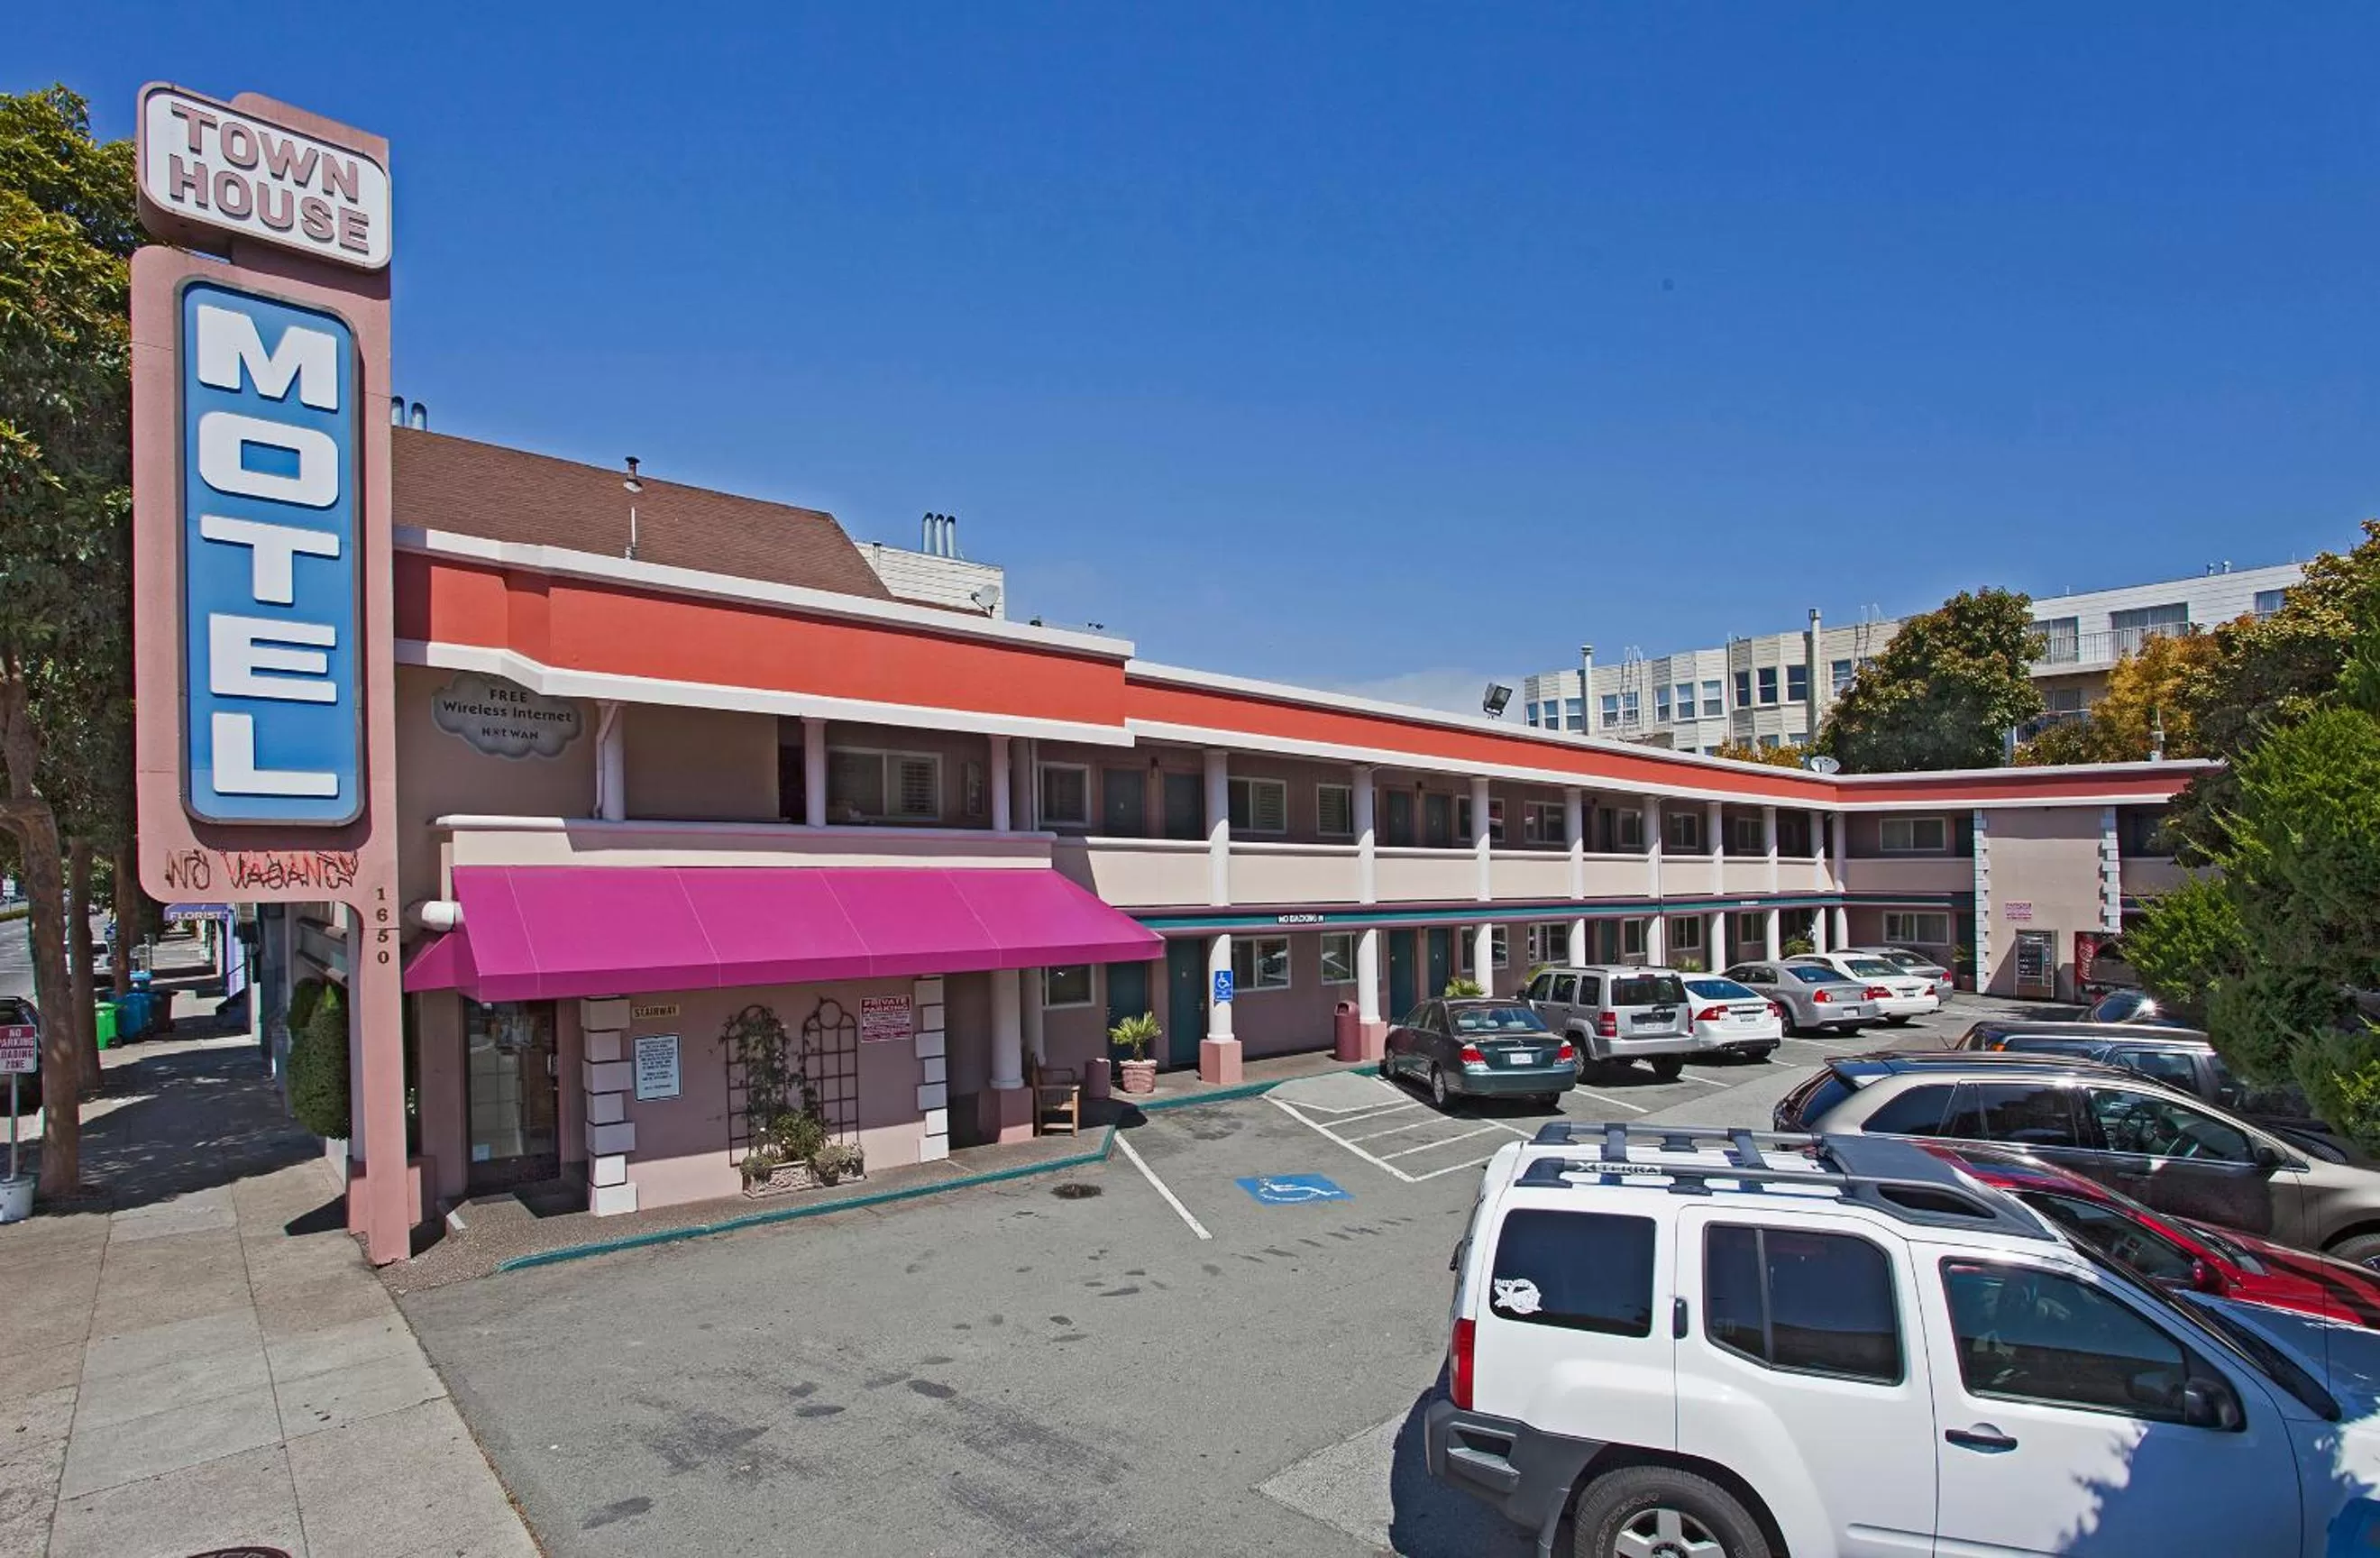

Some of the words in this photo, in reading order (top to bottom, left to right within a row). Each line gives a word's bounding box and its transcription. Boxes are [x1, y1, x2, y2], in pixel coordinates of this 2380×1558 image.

[171, 102, 358, 204] TOWN
[169, 154, 369, 254] HOUSE
[197, 304, 339, 797] MOTEL
[490, 689, 527, 703] FREE
[444, 701, 508, 717] Wireless
[513, 706, 572, 722] Internet
[165, 849, 210, 889] NO
[169, 912, 222, 921] FLORIST
[377, 887, 389, 964] 1650
[864, 997, 907, 1007] PRIVATE
[9, 1028, 22, 1037] NO
[0, 1049, 34, 1059] OADING
